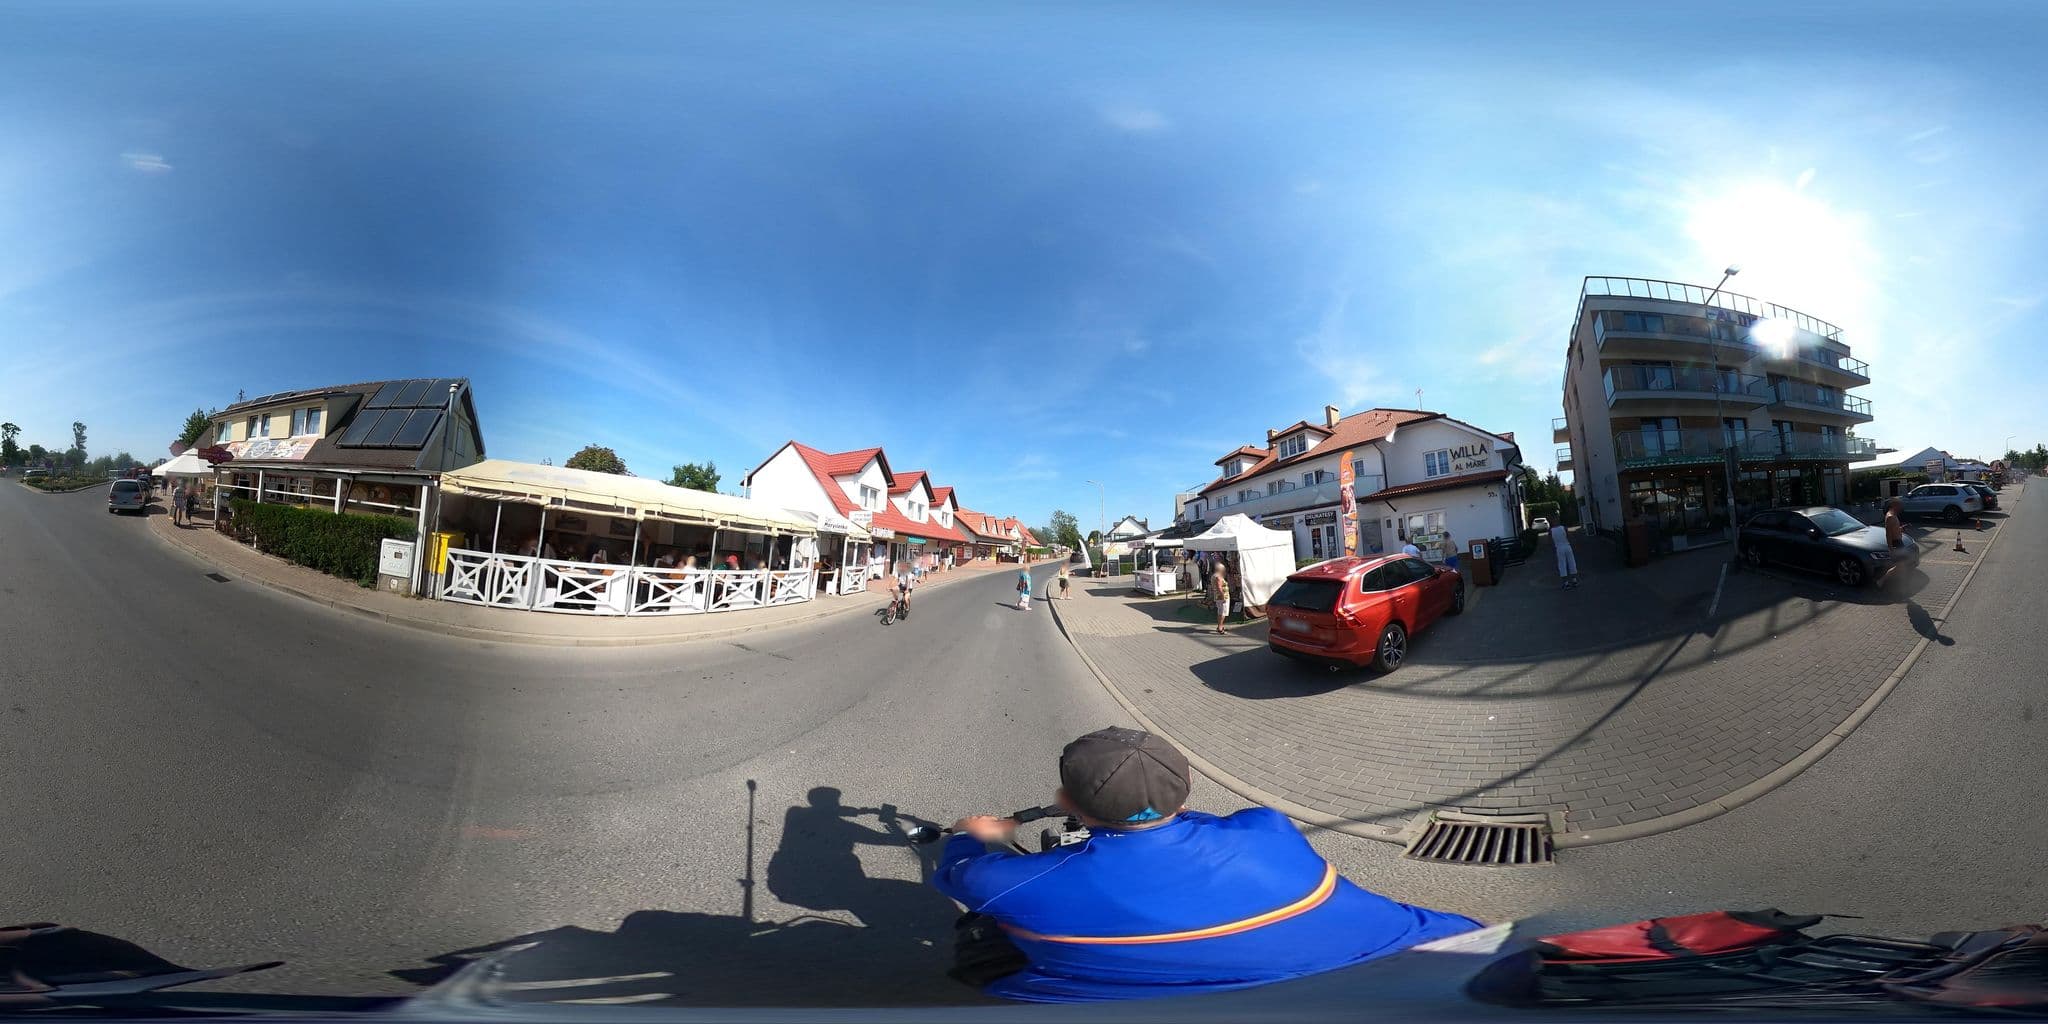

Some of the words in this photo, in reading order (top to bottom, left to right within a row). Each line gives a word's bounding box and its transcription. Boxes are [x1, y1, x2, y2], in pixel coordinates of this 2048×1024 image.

[1449, 443, 1488, 460] WILLA
[1454, 463, 1463, 472] AL
[1465, 459, 1487, 469] MARE
